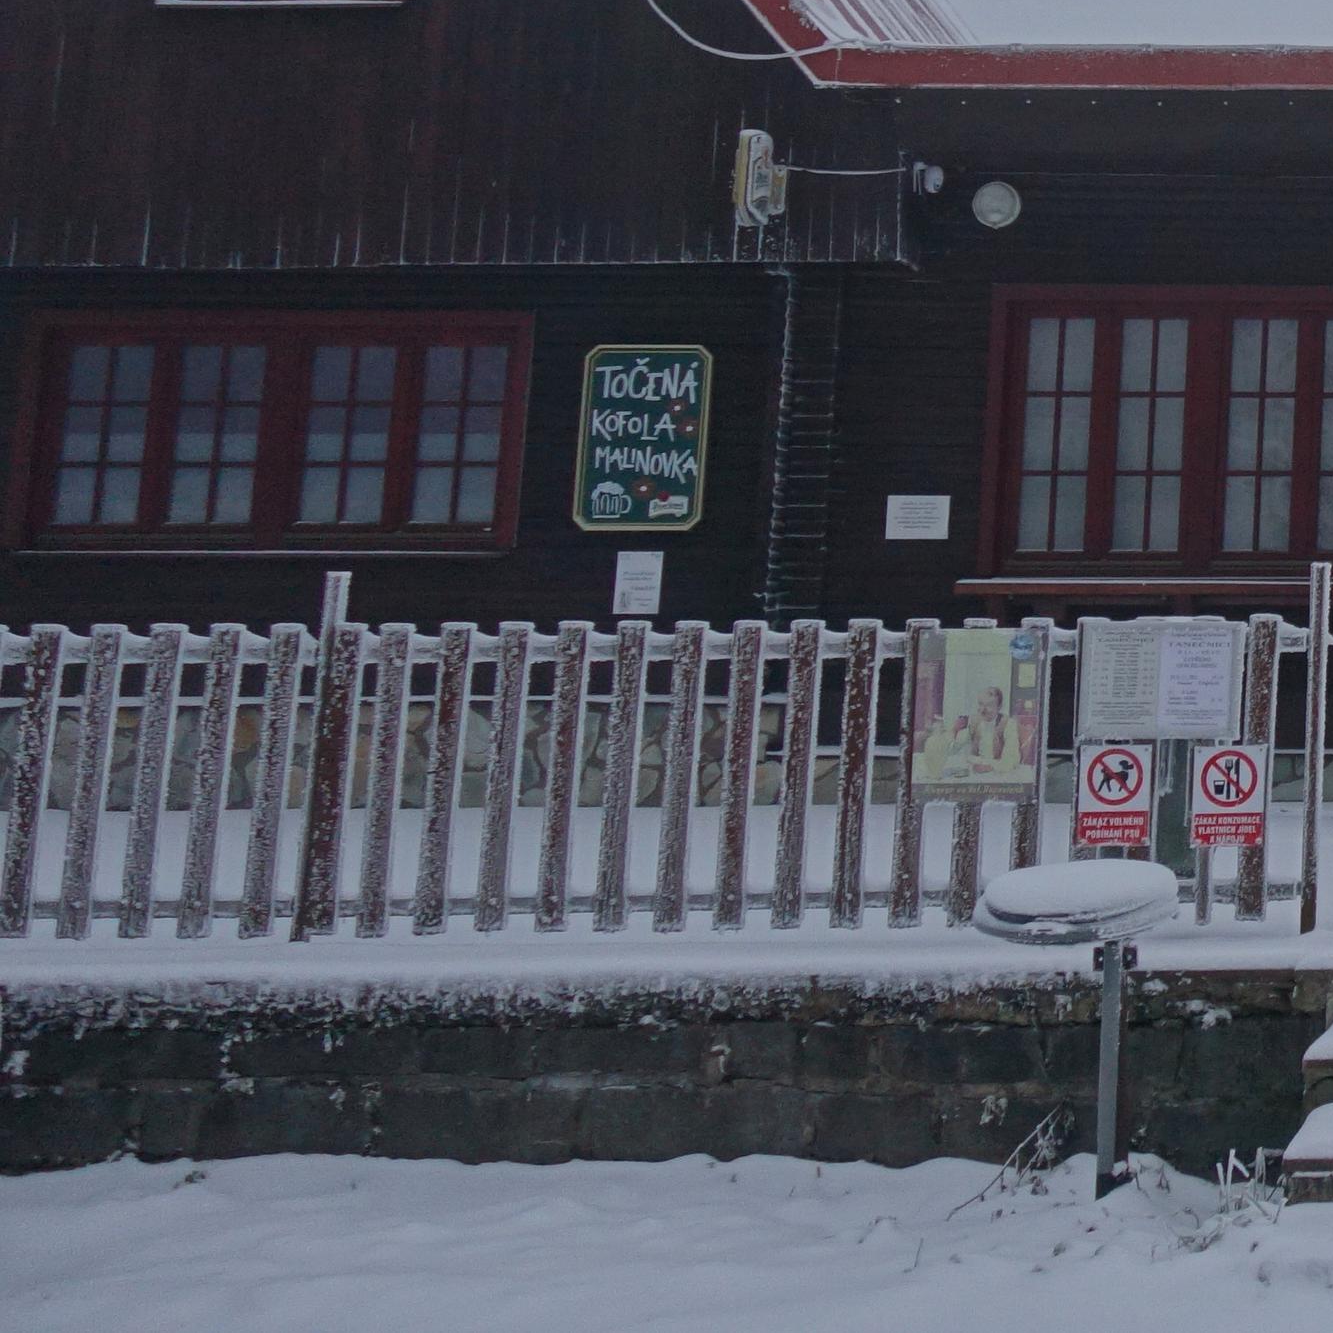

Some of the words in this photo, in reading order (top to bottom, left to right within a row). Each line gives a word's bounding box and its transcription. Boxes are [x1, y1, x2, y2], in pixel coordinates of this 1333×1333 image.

[595, 357, 699, 404] TOČENÁ
[591, 409, 677, 442] KOFOLA
[594, 445, 698, 484] MALINOVKA
